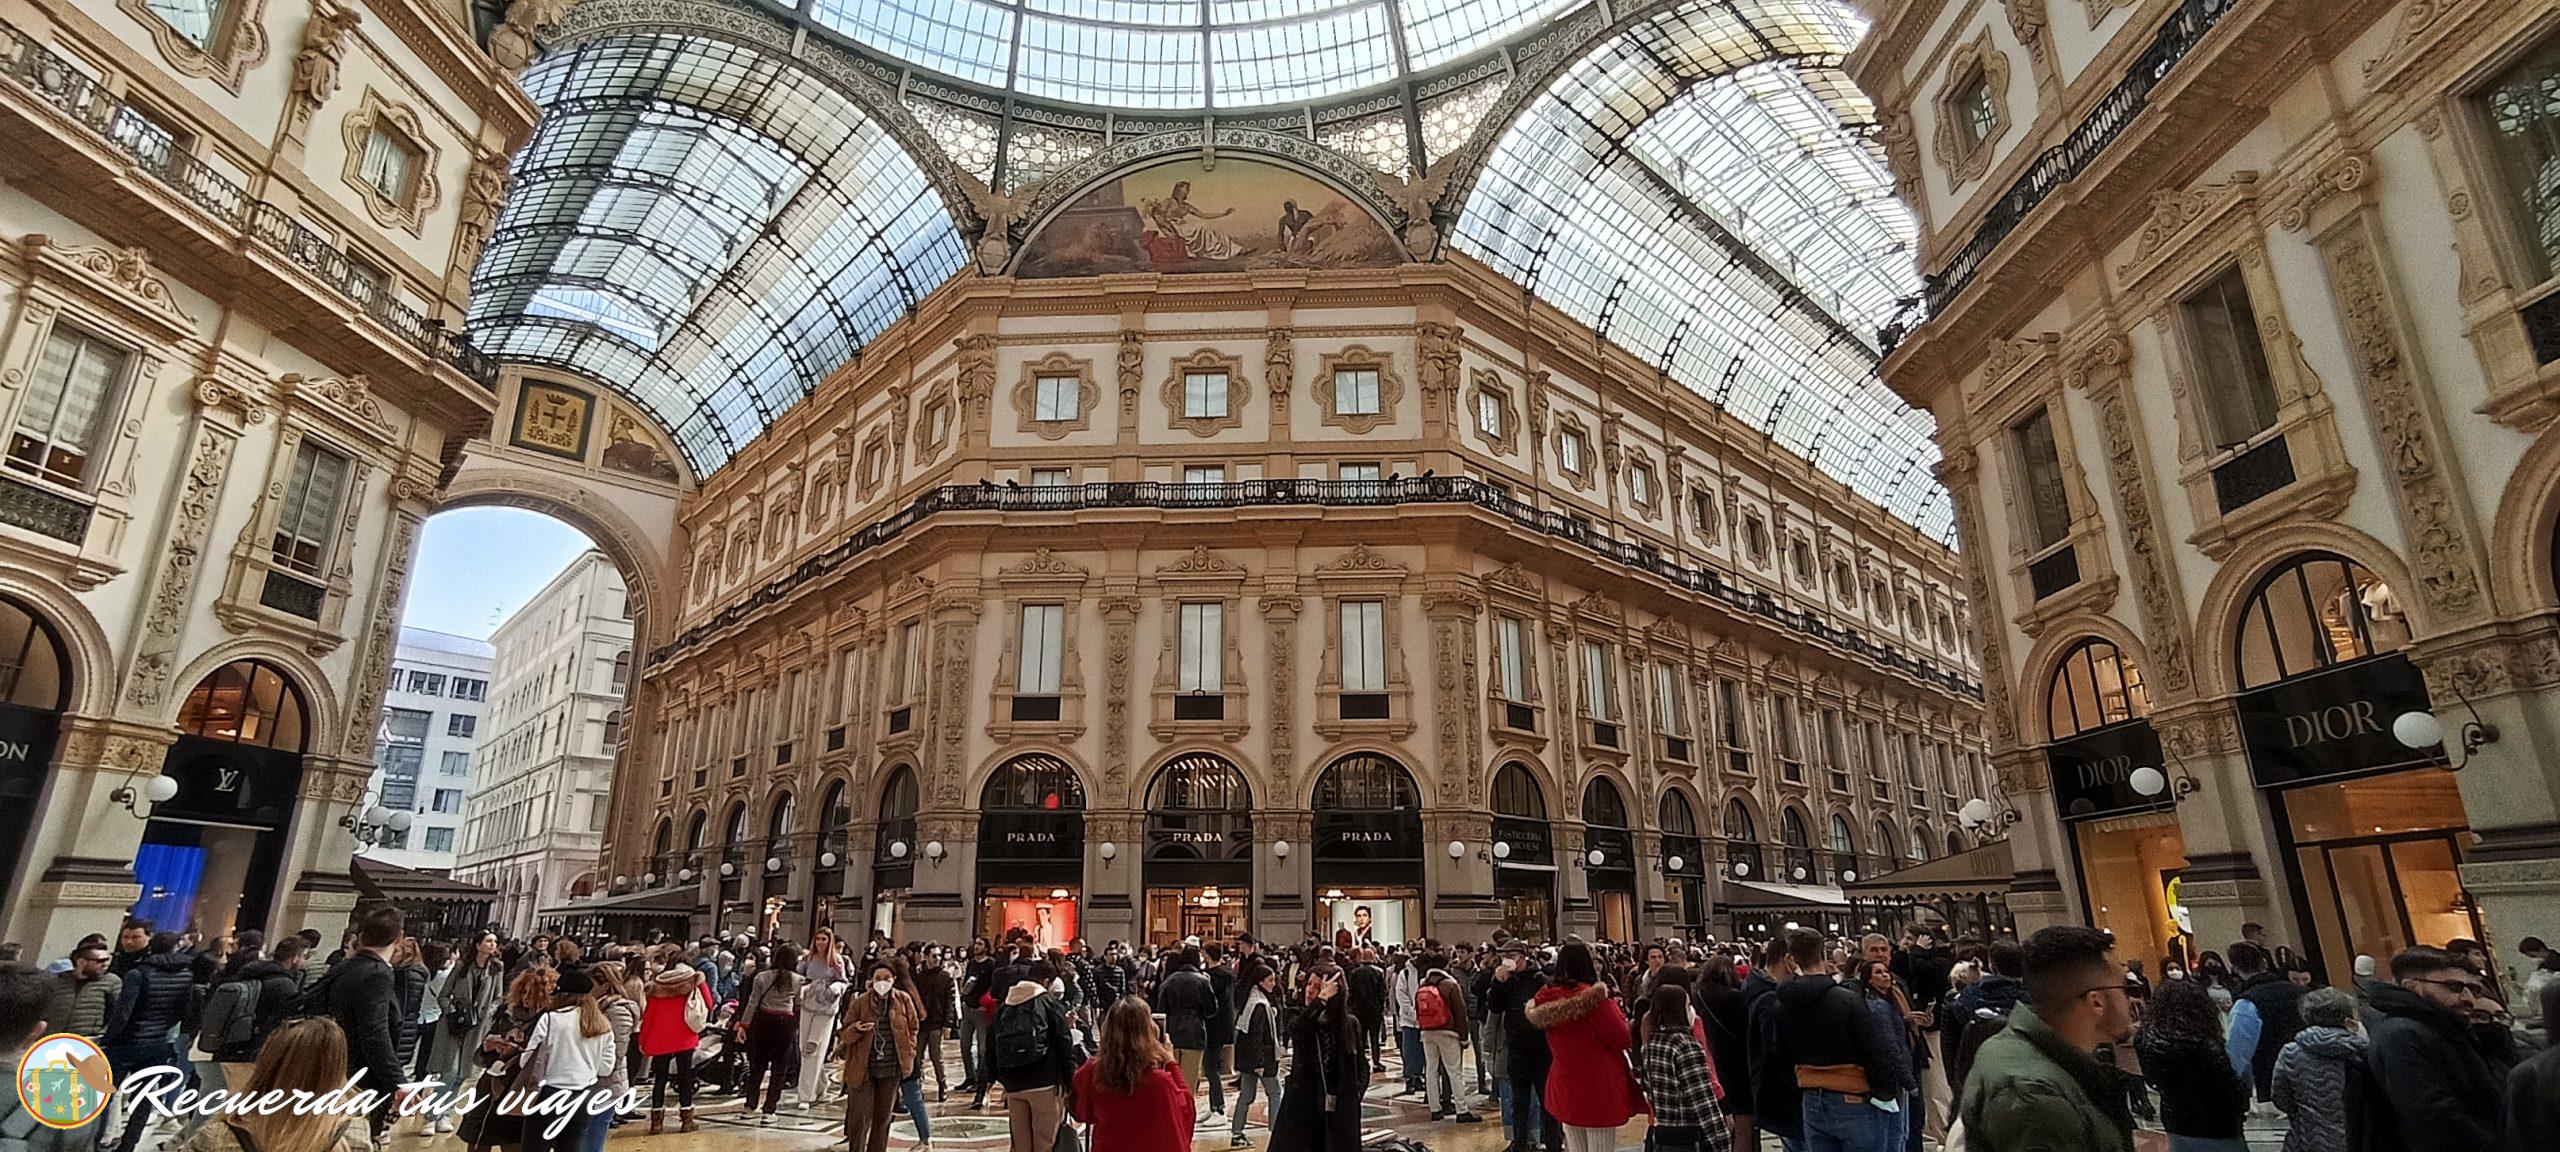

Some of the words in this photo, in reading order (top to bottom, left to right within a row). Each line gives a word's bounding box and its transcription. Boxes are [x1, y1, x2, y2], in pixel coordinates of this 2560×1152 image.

[2285, 700, 2384, 748] DIOR
[2076, 754, 2132, 790] DIOR
[1007, 832, 1056, 842] PRADA
[1173, 832, 1223, 842] PRADA
[1342, 832, 1392, 842] PRADA
[1505, 840, 1540, 852] ARCHESI
